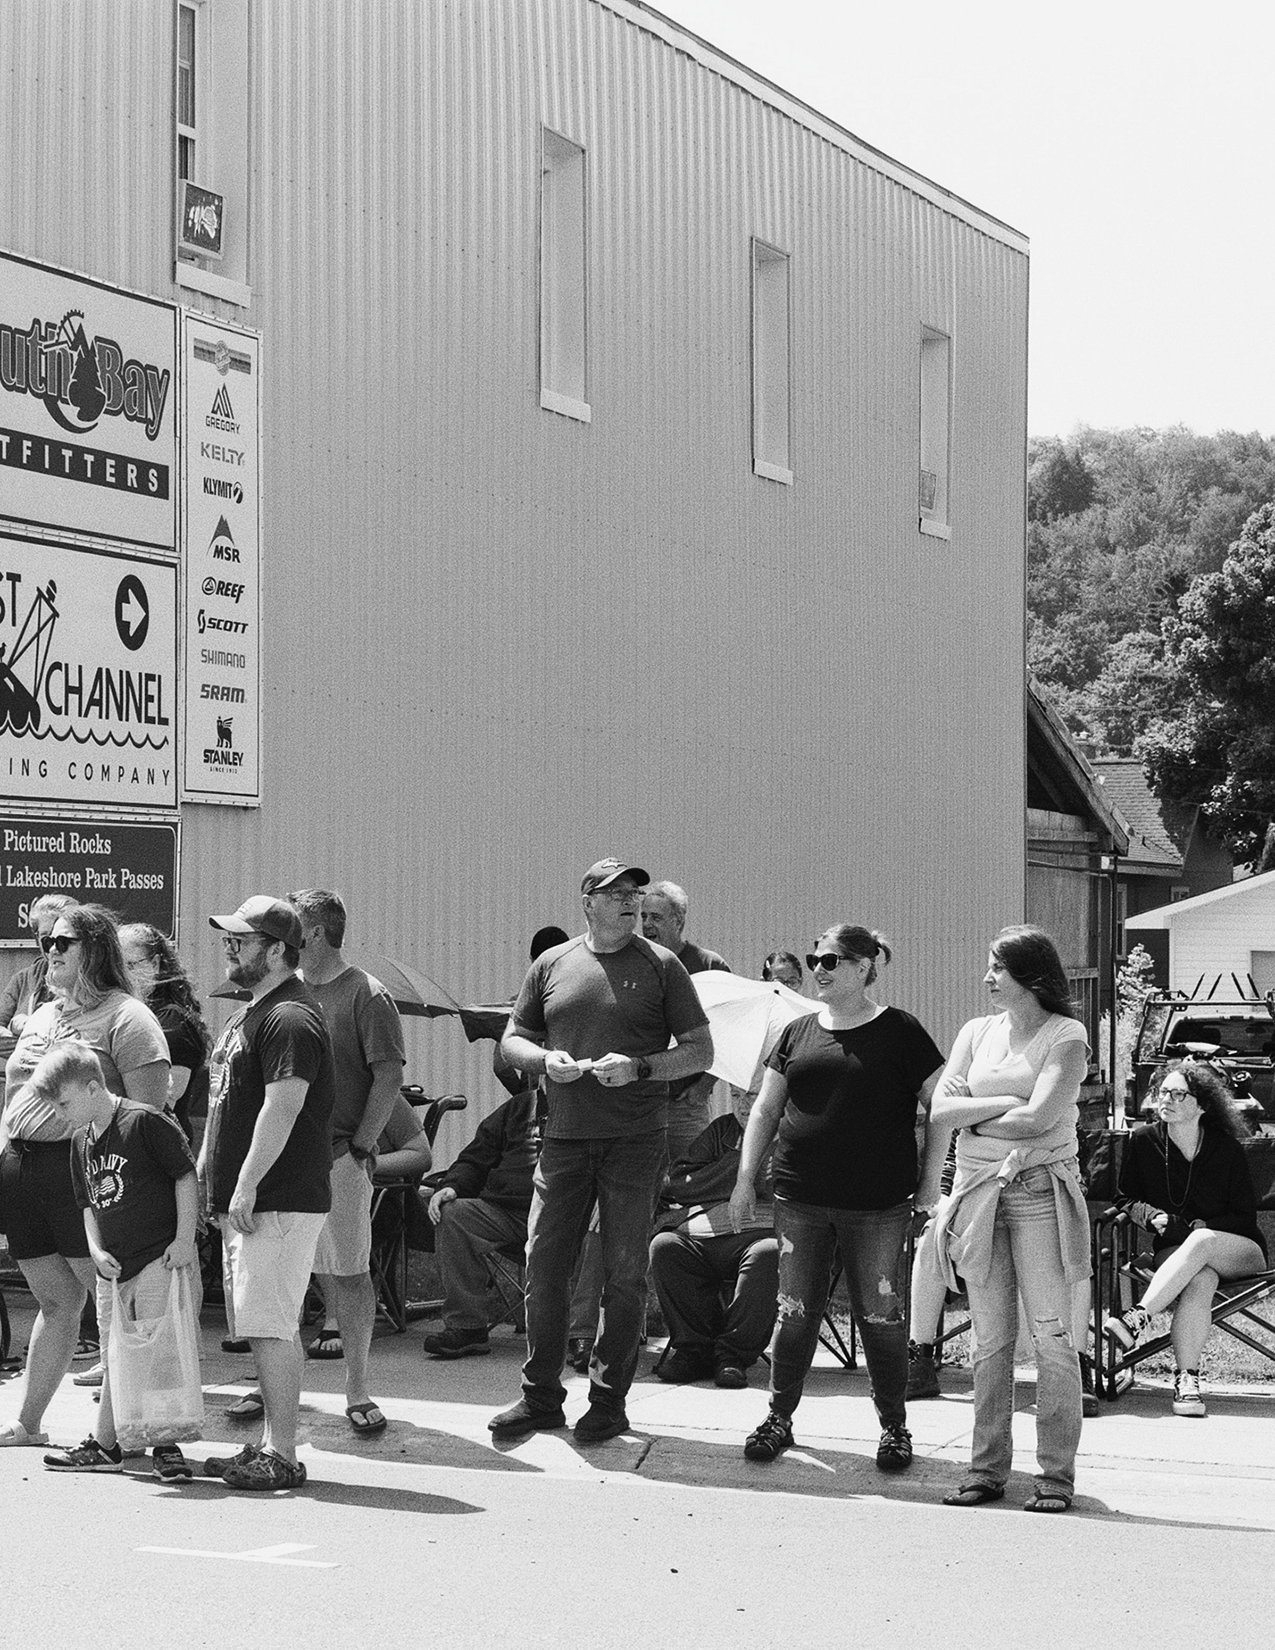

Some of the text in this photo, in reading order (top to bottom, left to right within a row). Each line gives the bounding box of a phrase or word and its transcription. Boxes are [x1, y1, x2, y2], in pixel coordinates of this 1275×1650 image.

[94, 335, 170, 441] Bay
[205, 415, 240, 434] GREGORY
[200, 441, 245, 466] KELTY
[203, 476, 232, 499] KLYMIT
[213, 545, 241, 563] MSR
[216, 580, 245, 603] REEF
[207, 617, 248, 634] SCOTT
[201, 649, 245, 668] SHIMANO
[45, 661, 169, 726] CHANNEL
[200, 684, 245, 703] SRAM
[203, 749, 244, 766] STANLEY
[68, 761, 170, 786] COMPANY
[3, 829, 112, 855] Pictured Rocks
[6, 865, 81, 889] Lakeshore
[85, 867, 117, 889] Park
[120, 868, 164, 890] Passes
